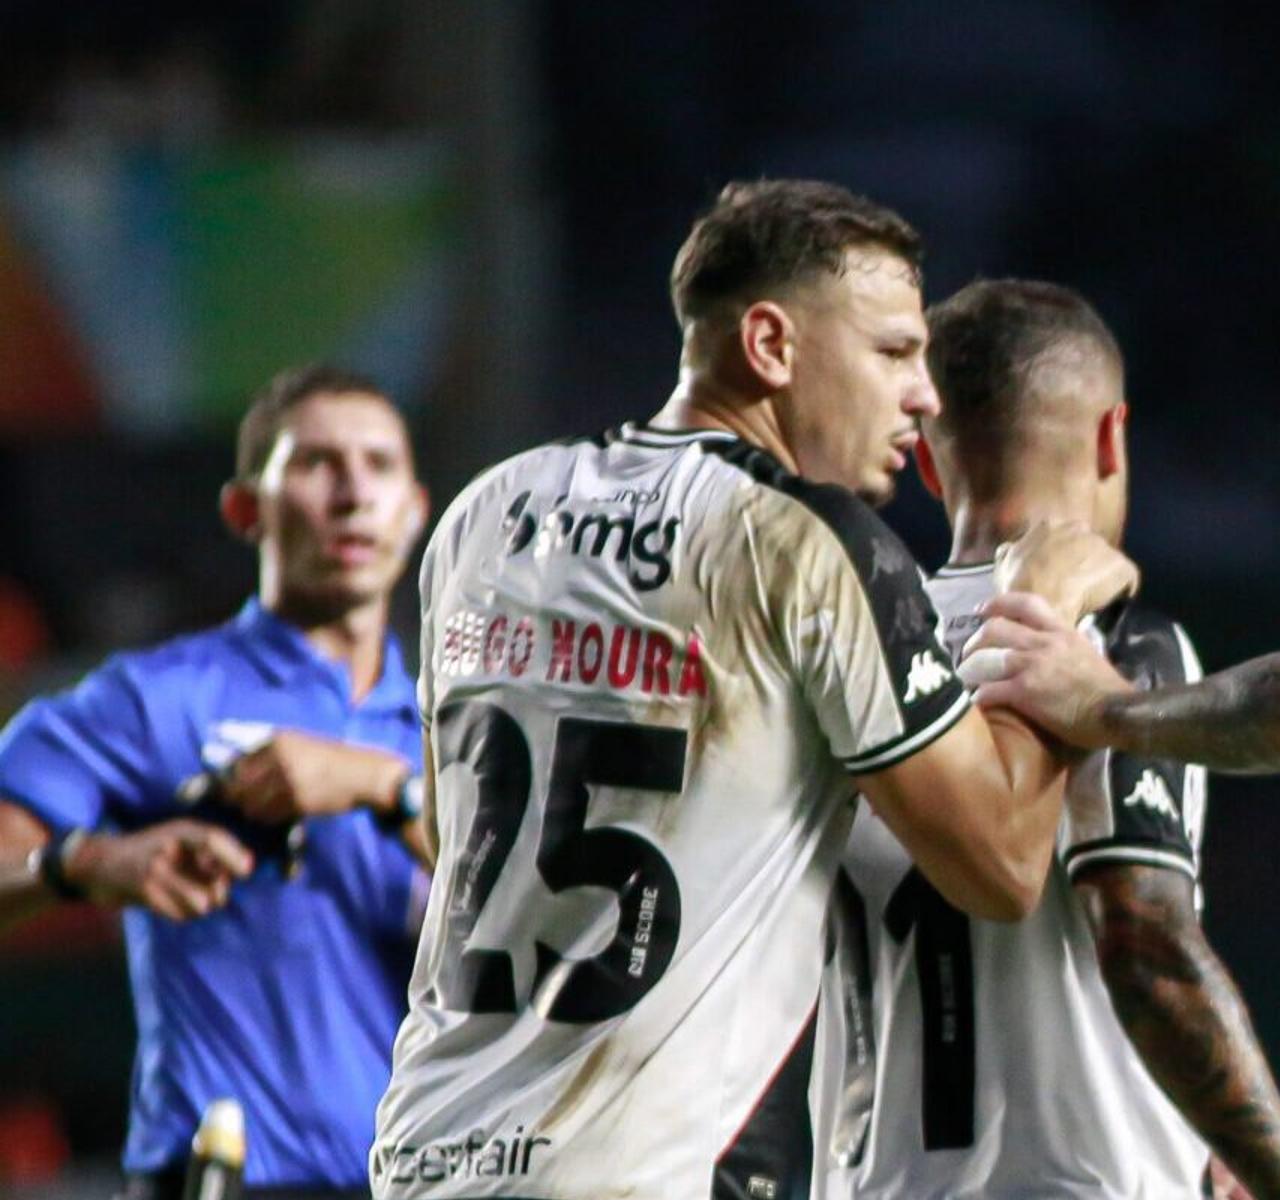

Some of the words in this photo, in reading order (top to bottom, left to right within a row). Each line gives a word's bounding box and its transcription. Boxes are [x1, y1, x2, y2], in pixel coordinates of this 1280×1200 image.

[545, 619, 708, 698] MOURA
[418, 702, 689, 1025] 25
[635, 886, 660, 944] SCORE
